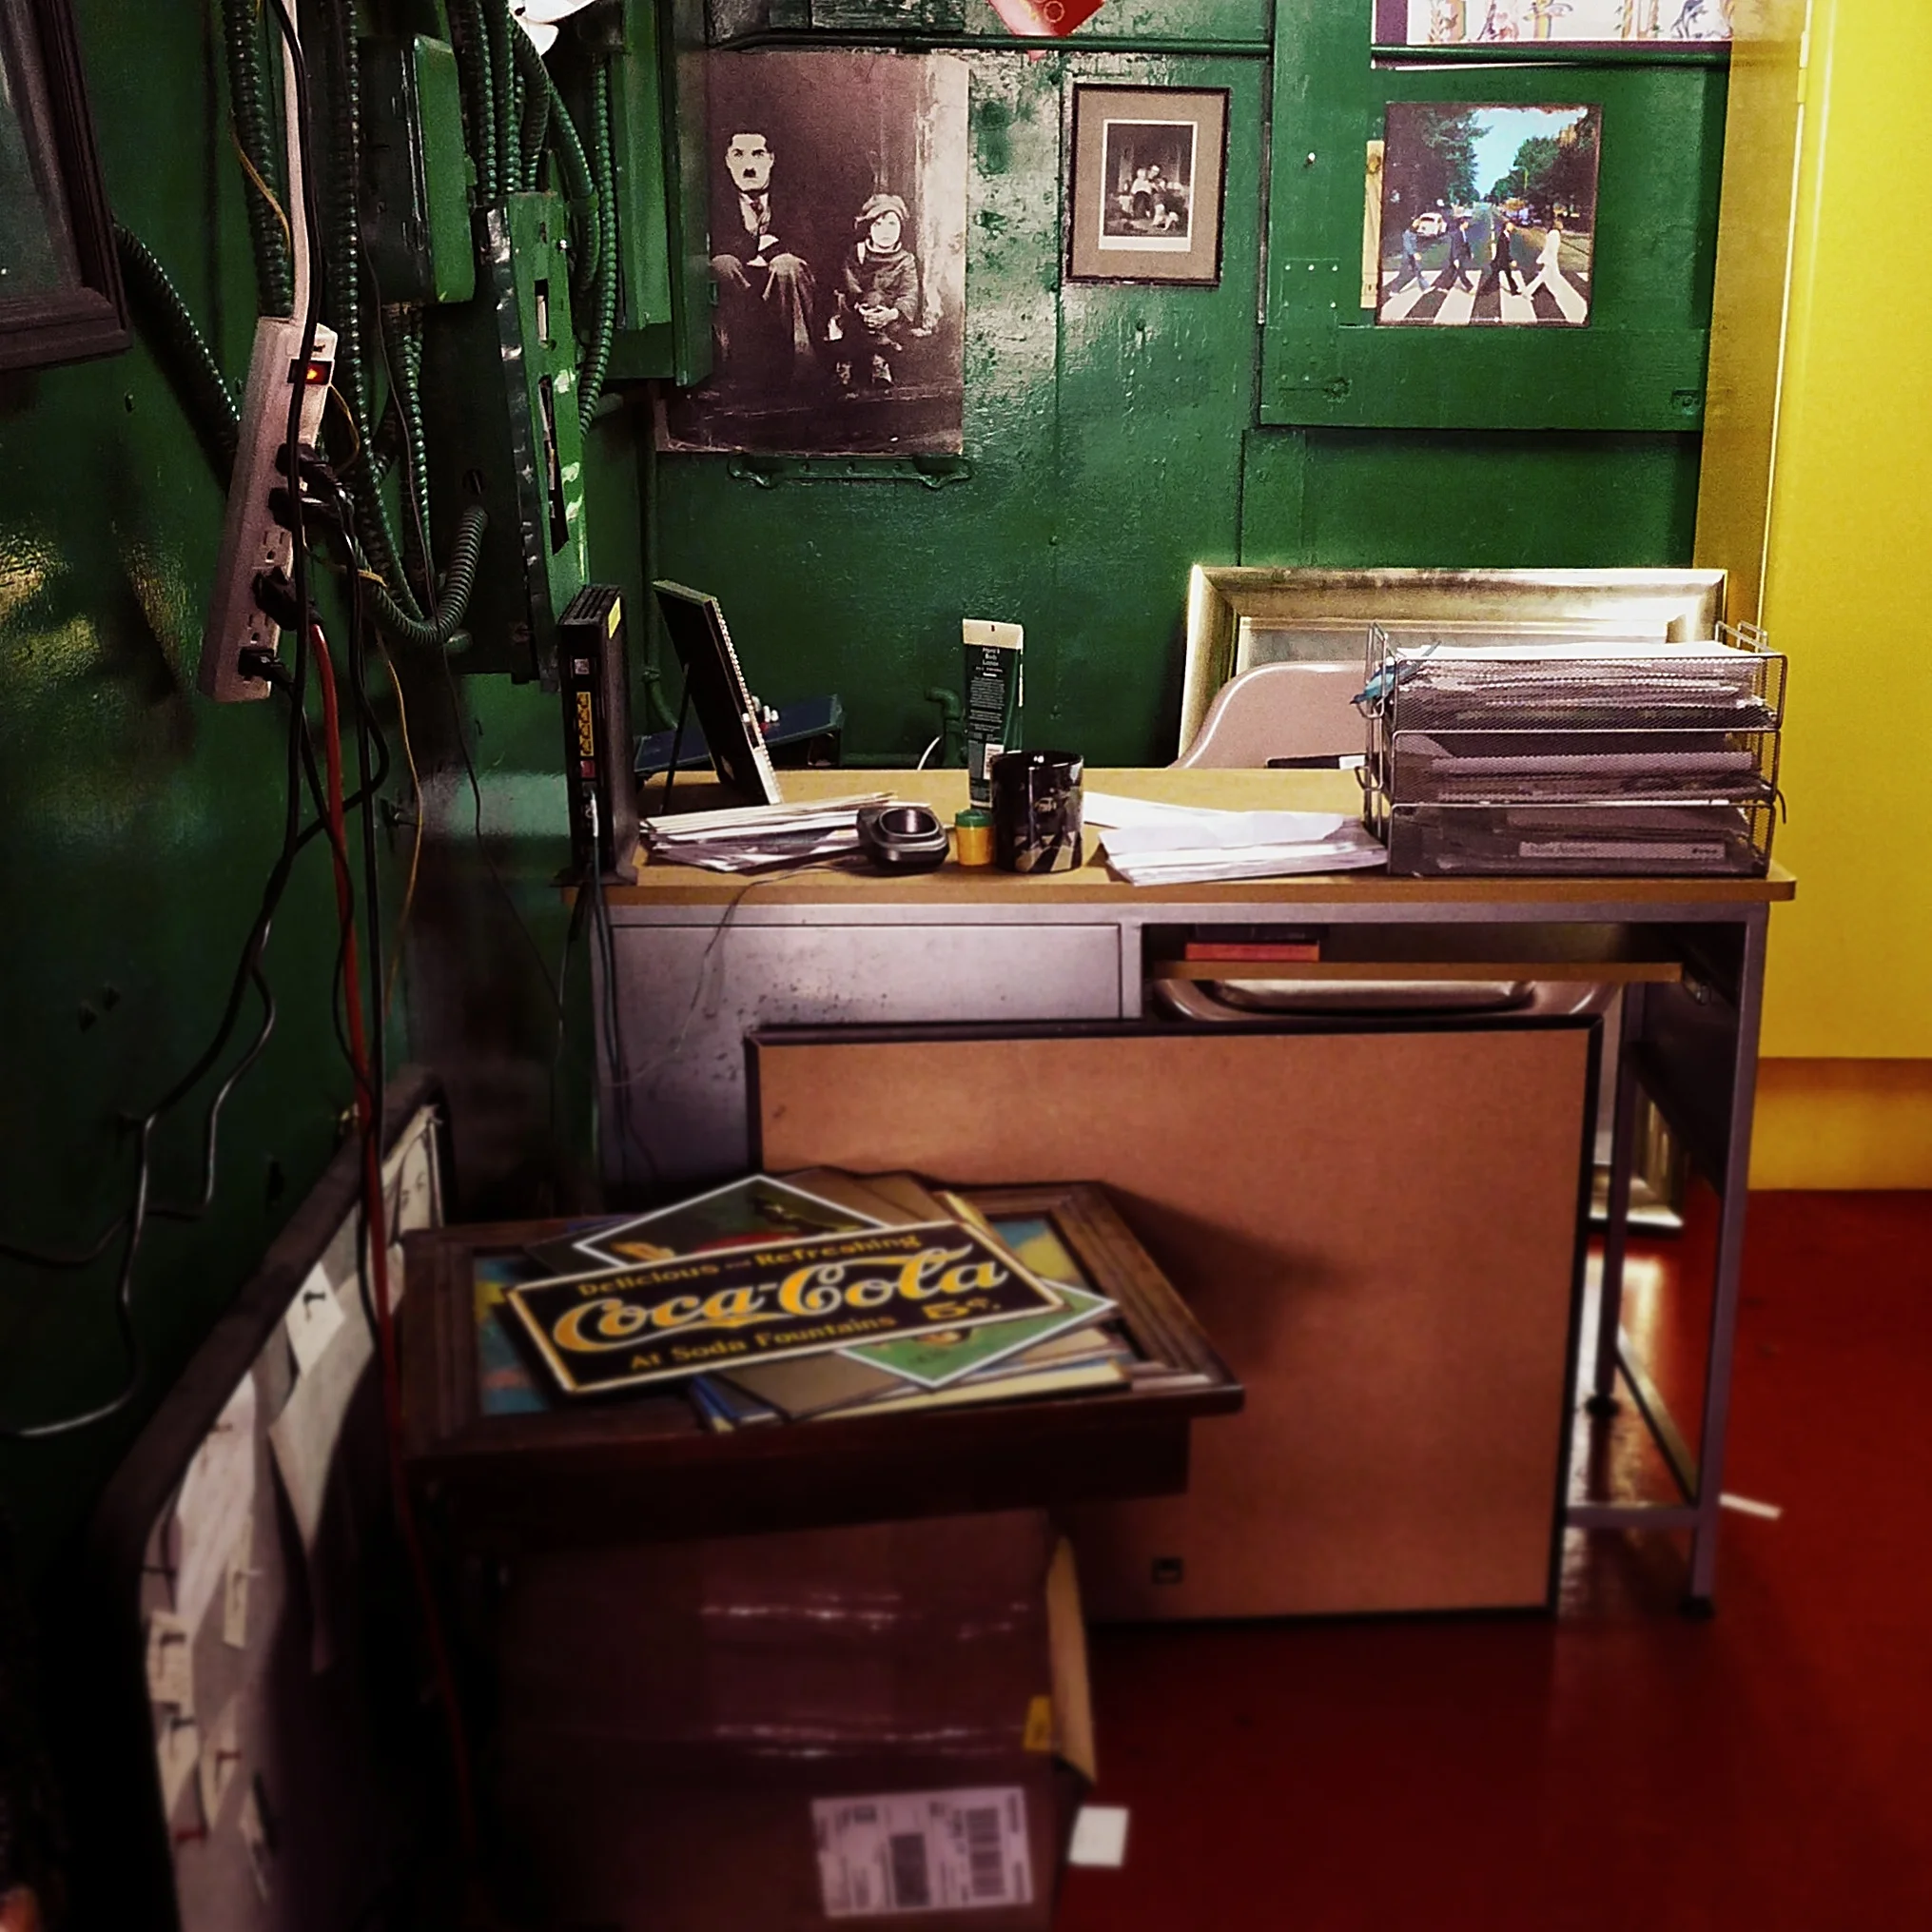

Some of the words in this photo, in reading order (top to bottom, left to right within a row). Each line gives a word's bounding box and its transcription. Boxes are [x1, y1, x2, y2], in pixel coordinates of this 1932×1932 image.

[578, 1264, 720, 1296] Delicious
[754, 1234, 923, 1266] Refreshing
[552, 1242, 1009, 1352] Coca-Cola
[631, 1354, 661, 1370] At
[672, 1340, 748, 1360] Soda
[754, 1317, 898, 1347] Fountains
